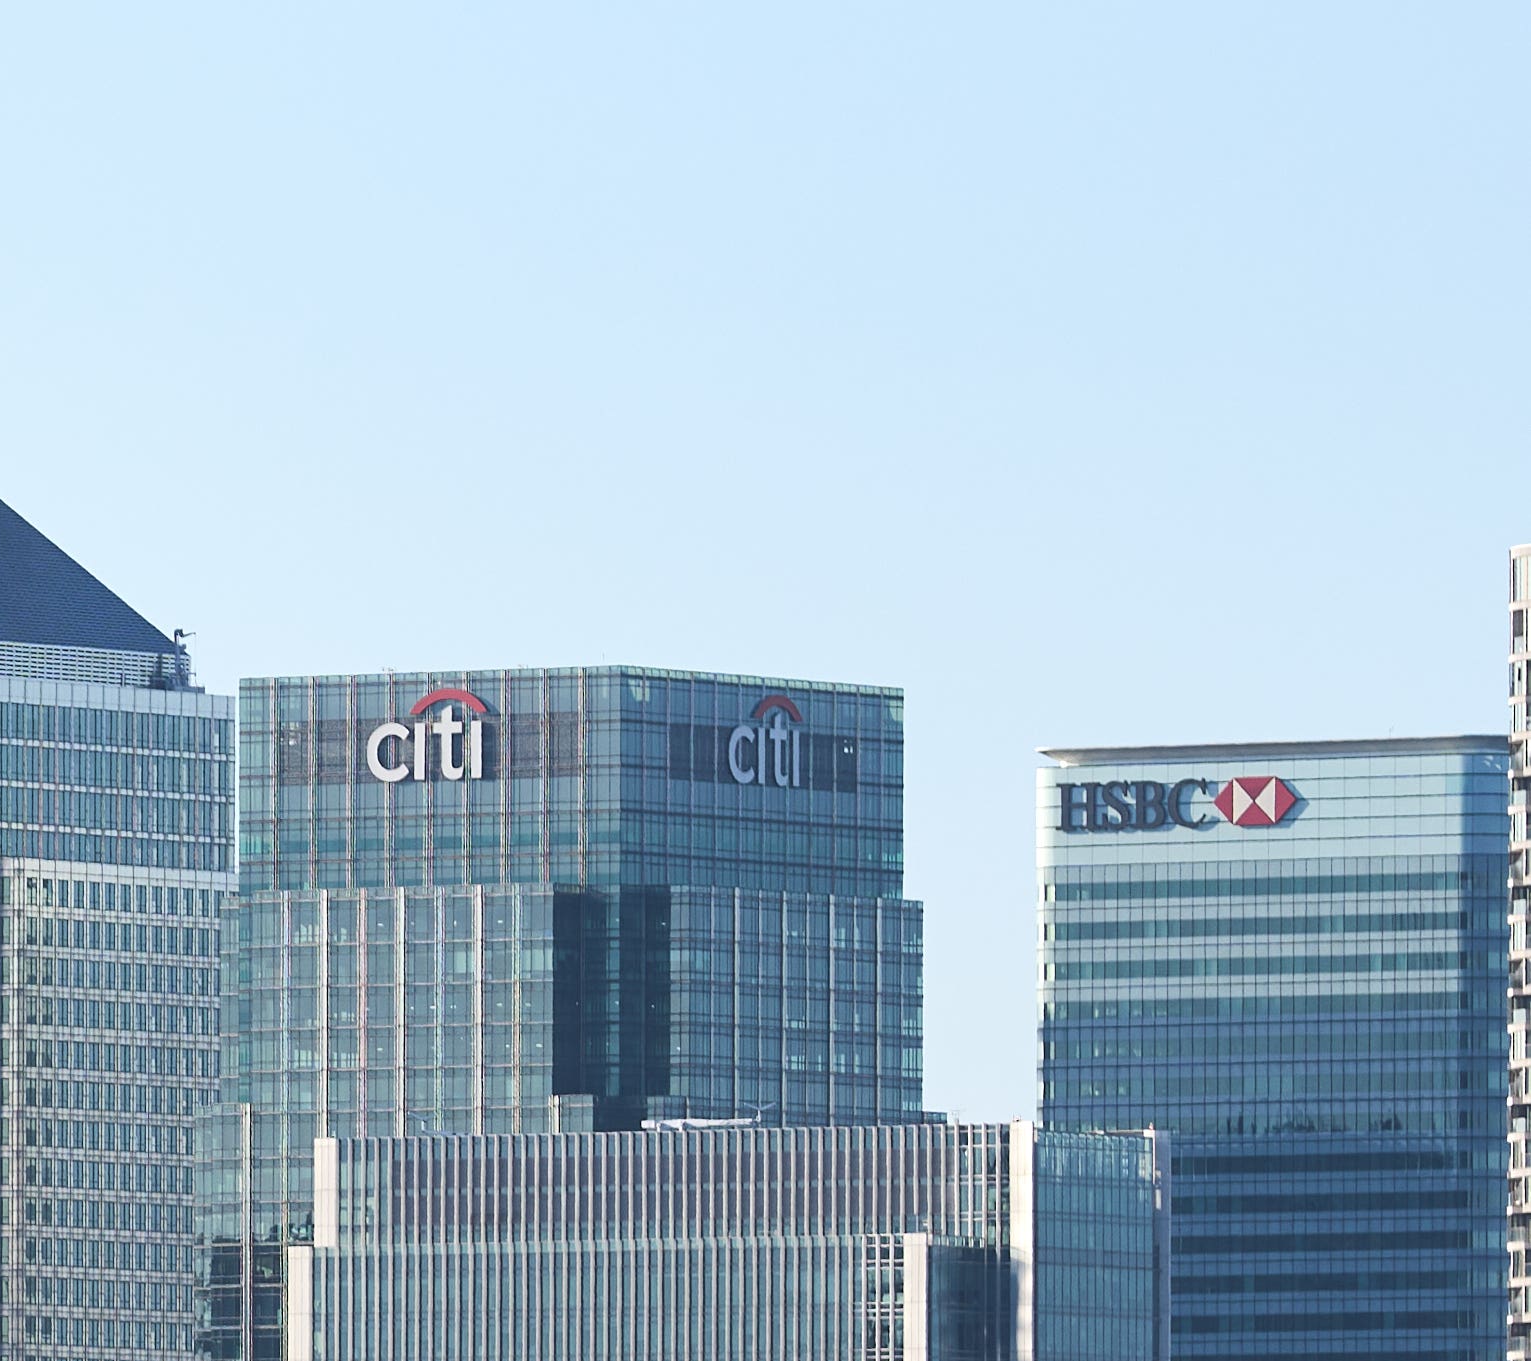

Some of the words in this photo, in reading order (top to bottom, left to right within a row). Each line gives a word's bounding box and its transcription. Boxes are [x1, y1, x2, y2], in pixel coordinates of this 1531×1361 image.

[367, 704, 483, 783] citi
[728, 710, 800, 787] citi
[1055, 777, 1208, 832] HSBC
